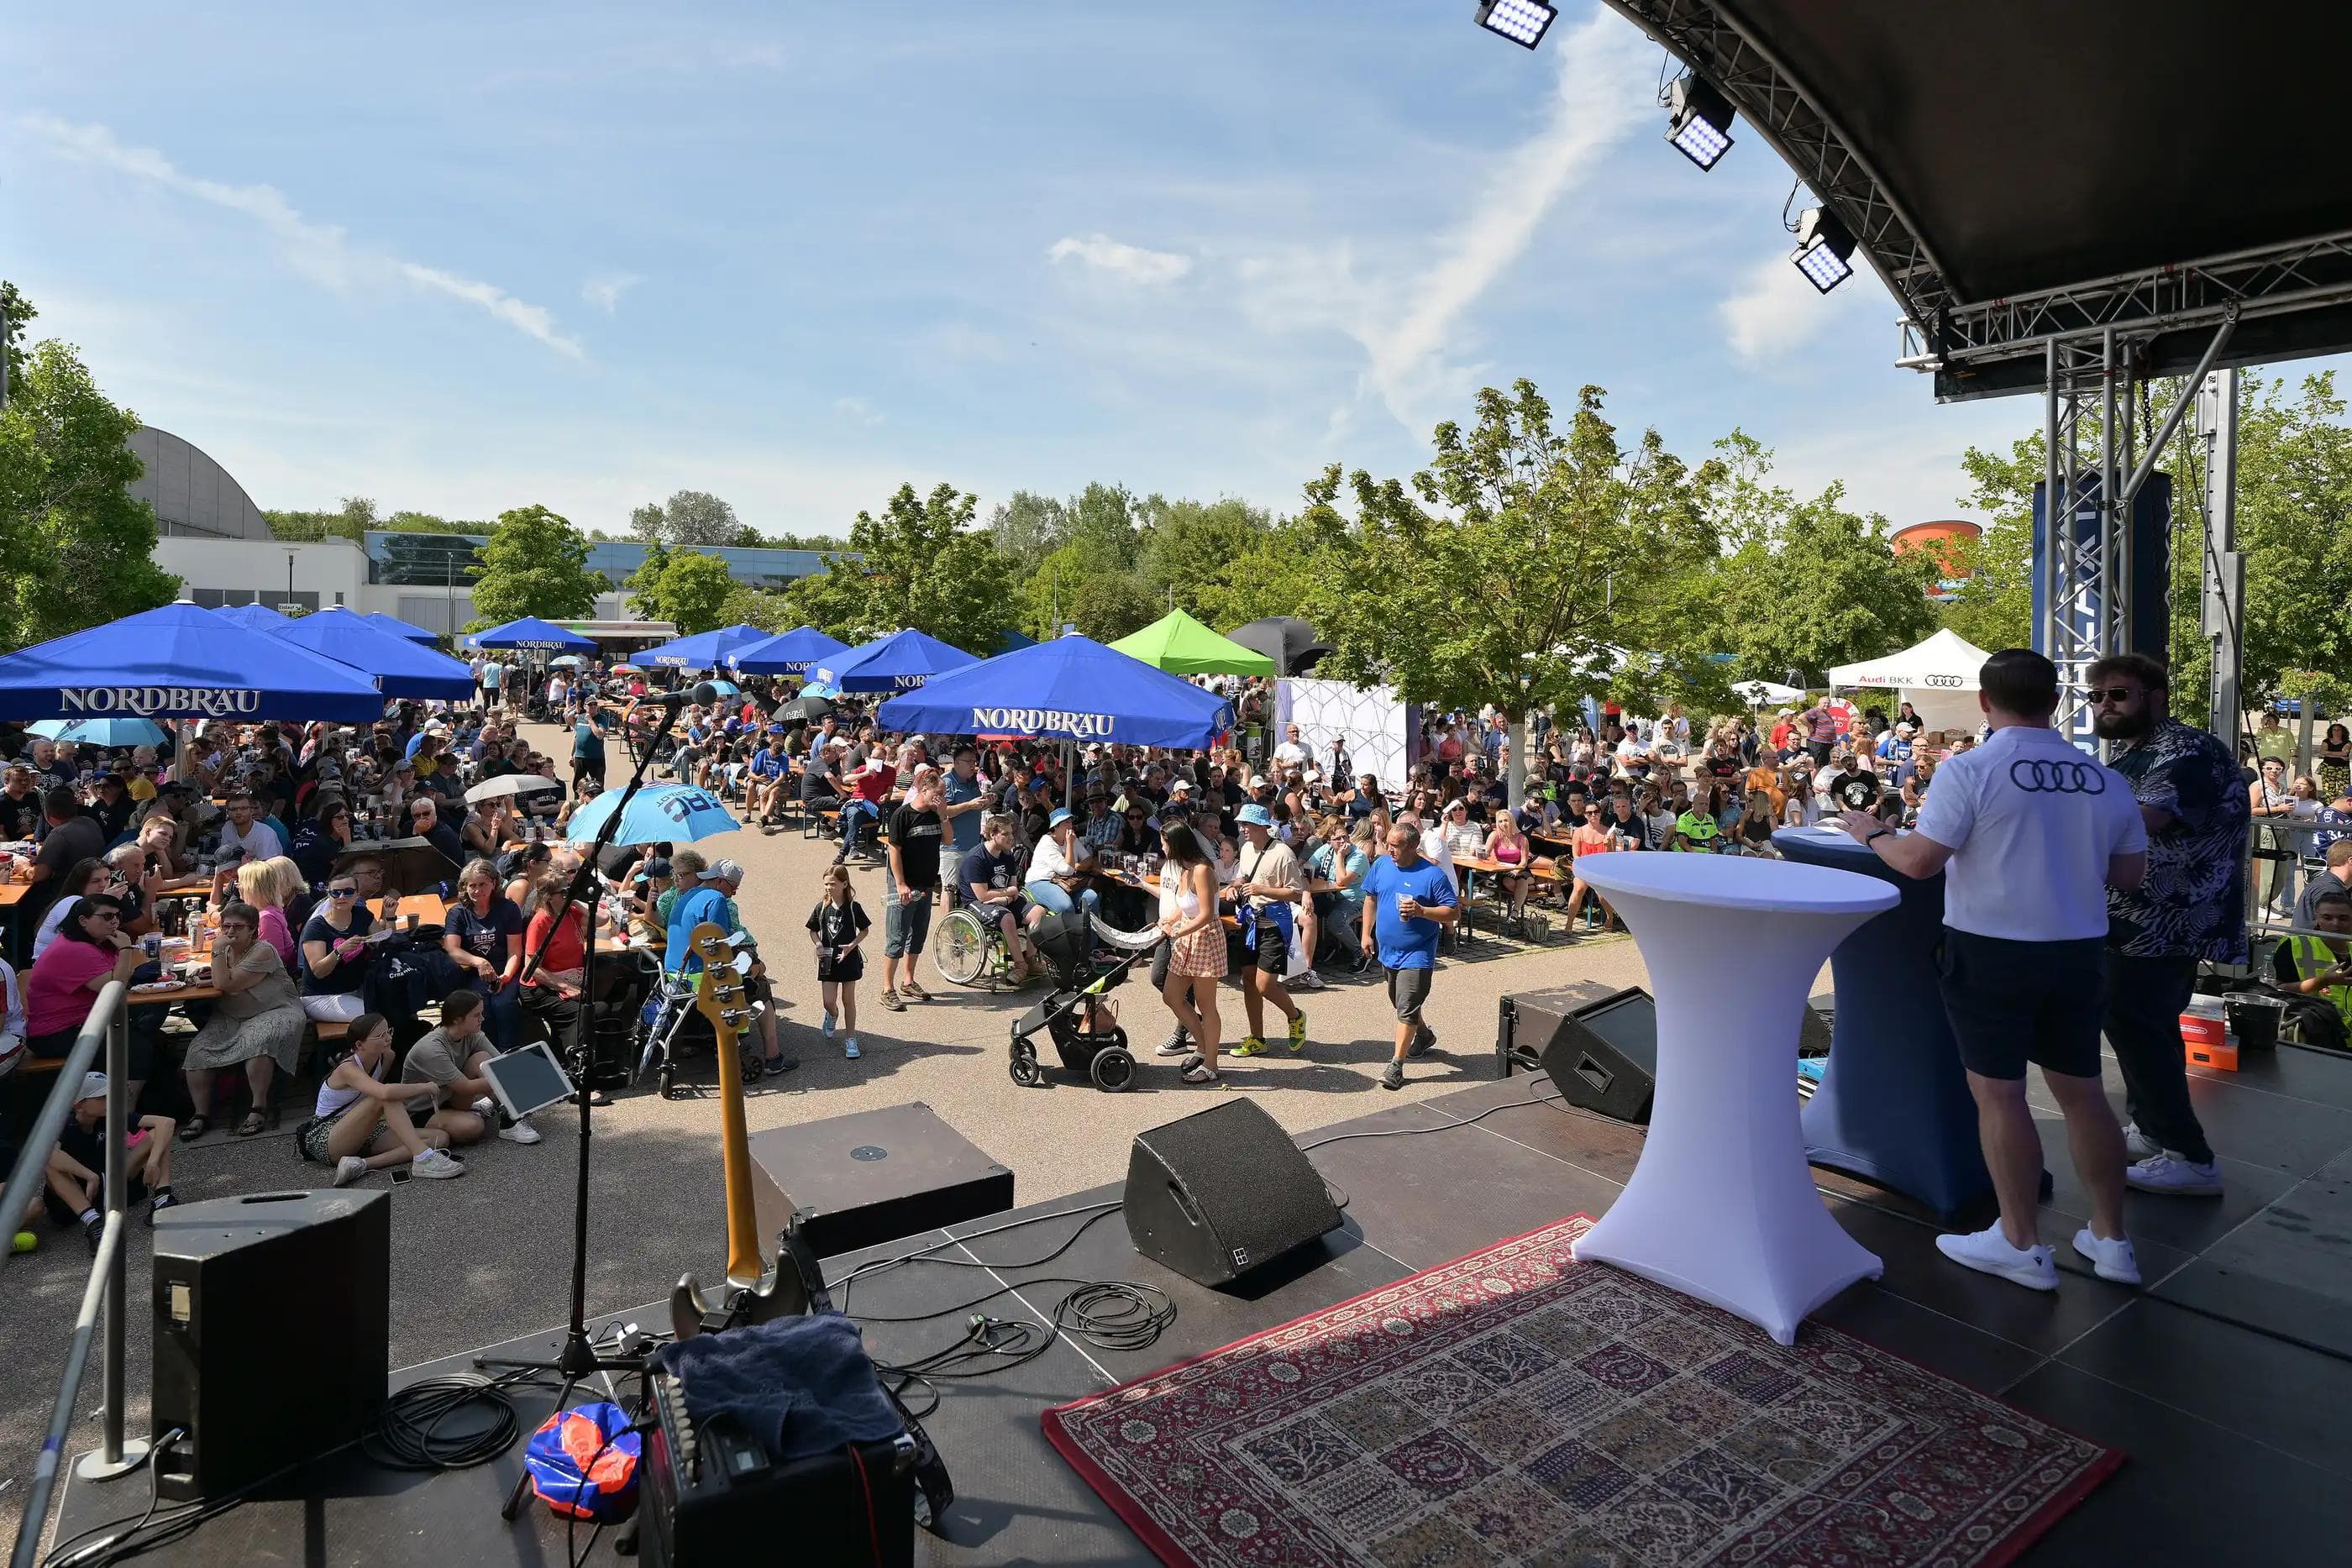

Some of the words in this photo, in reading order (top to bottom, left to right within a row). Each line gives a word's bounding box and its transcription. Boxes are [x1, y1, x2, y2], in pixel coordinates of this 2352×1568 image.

[515, 639, 566, 650] NORDBRÄU
[654, 655, 690, 667] NORDBRÄU
[1859, 675, 1886, 684] Audi
[1889, 676, 1914, 684] BKK
[59, 687, 261, 717] NORDBRÄU
[971, 707, 1116, 738] NORDBRÄU
